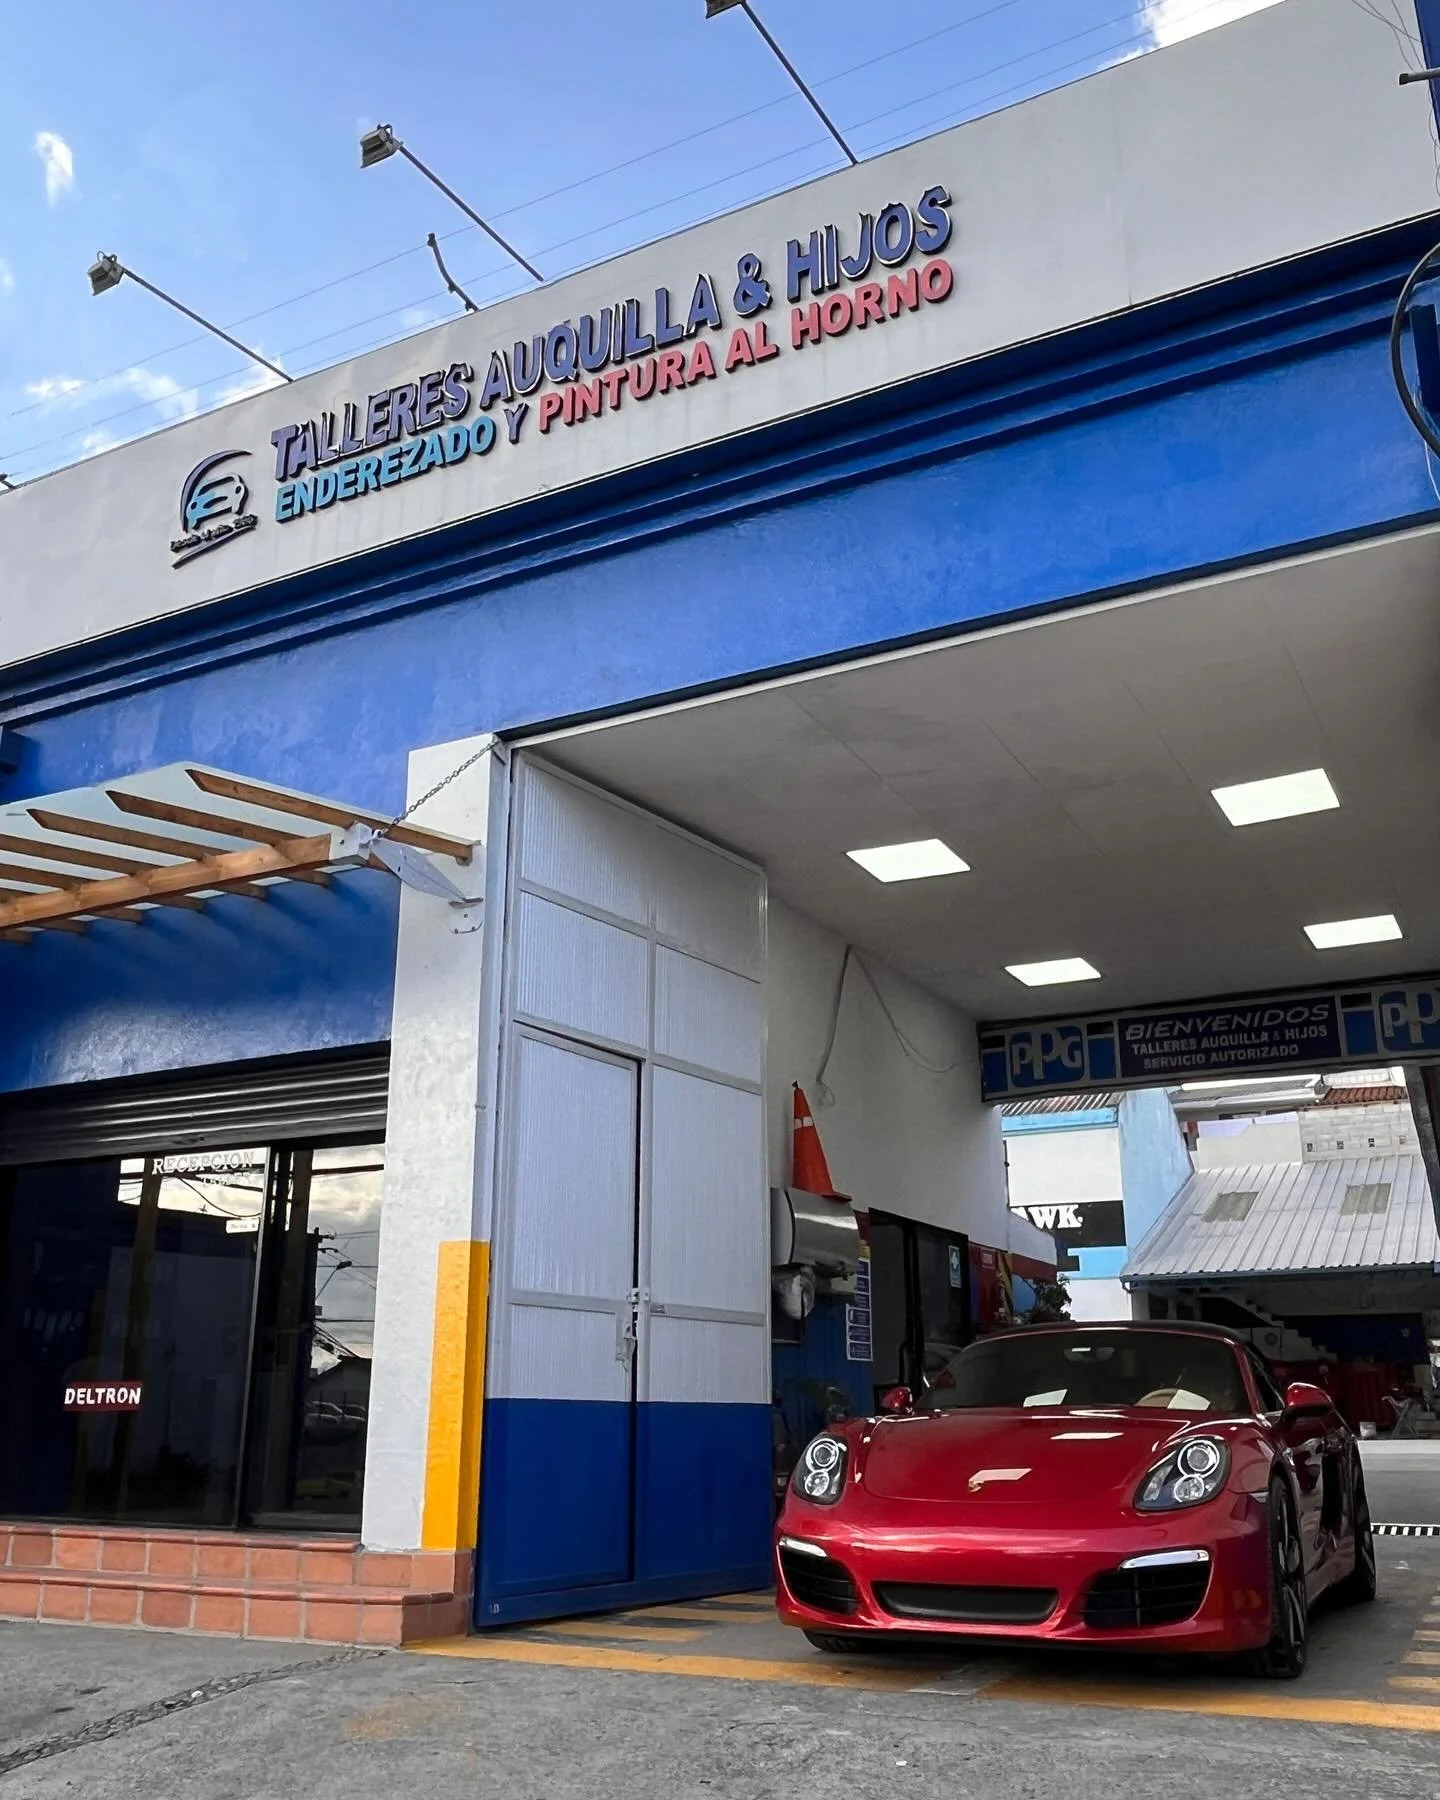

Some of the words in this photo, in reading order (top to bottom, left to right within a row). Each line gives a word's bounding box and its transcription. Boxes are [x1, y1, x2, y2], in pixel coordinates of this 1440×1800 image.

[271, 363, 474, 482] TALLERES
[480, 271, 721, 411] AUQUILLA
[733, 252, 772, 318] &
[786, 184, 952, 304] HIJOS
[275, 414, 496, 523] ENDEREZADO
[505, 402, 530, 444] Y
[539, 341, 716, 433] PINTURA
[725, 320, 779, 373] AL
[791, 258, 954, 350] HORNO
[1125, 1003, 1330, 1041] BIENVENIDOS
[1382, 989, 1440, 1044] PP
[1011, 1027, 1082, 1080] PPG
[1131, 1037, 1198, 1056] TALLERES
[1201, 1031, 1270, 1049] AUQUILLA
[1285, 1024, 1329, 1041] HIJOS
[1144, 1054, 1207, 1070] SERVICIO
[1209, 1043, 1300, 1064] AUTORIZADO
[64, 1387, 142, 1404] DELTRON
